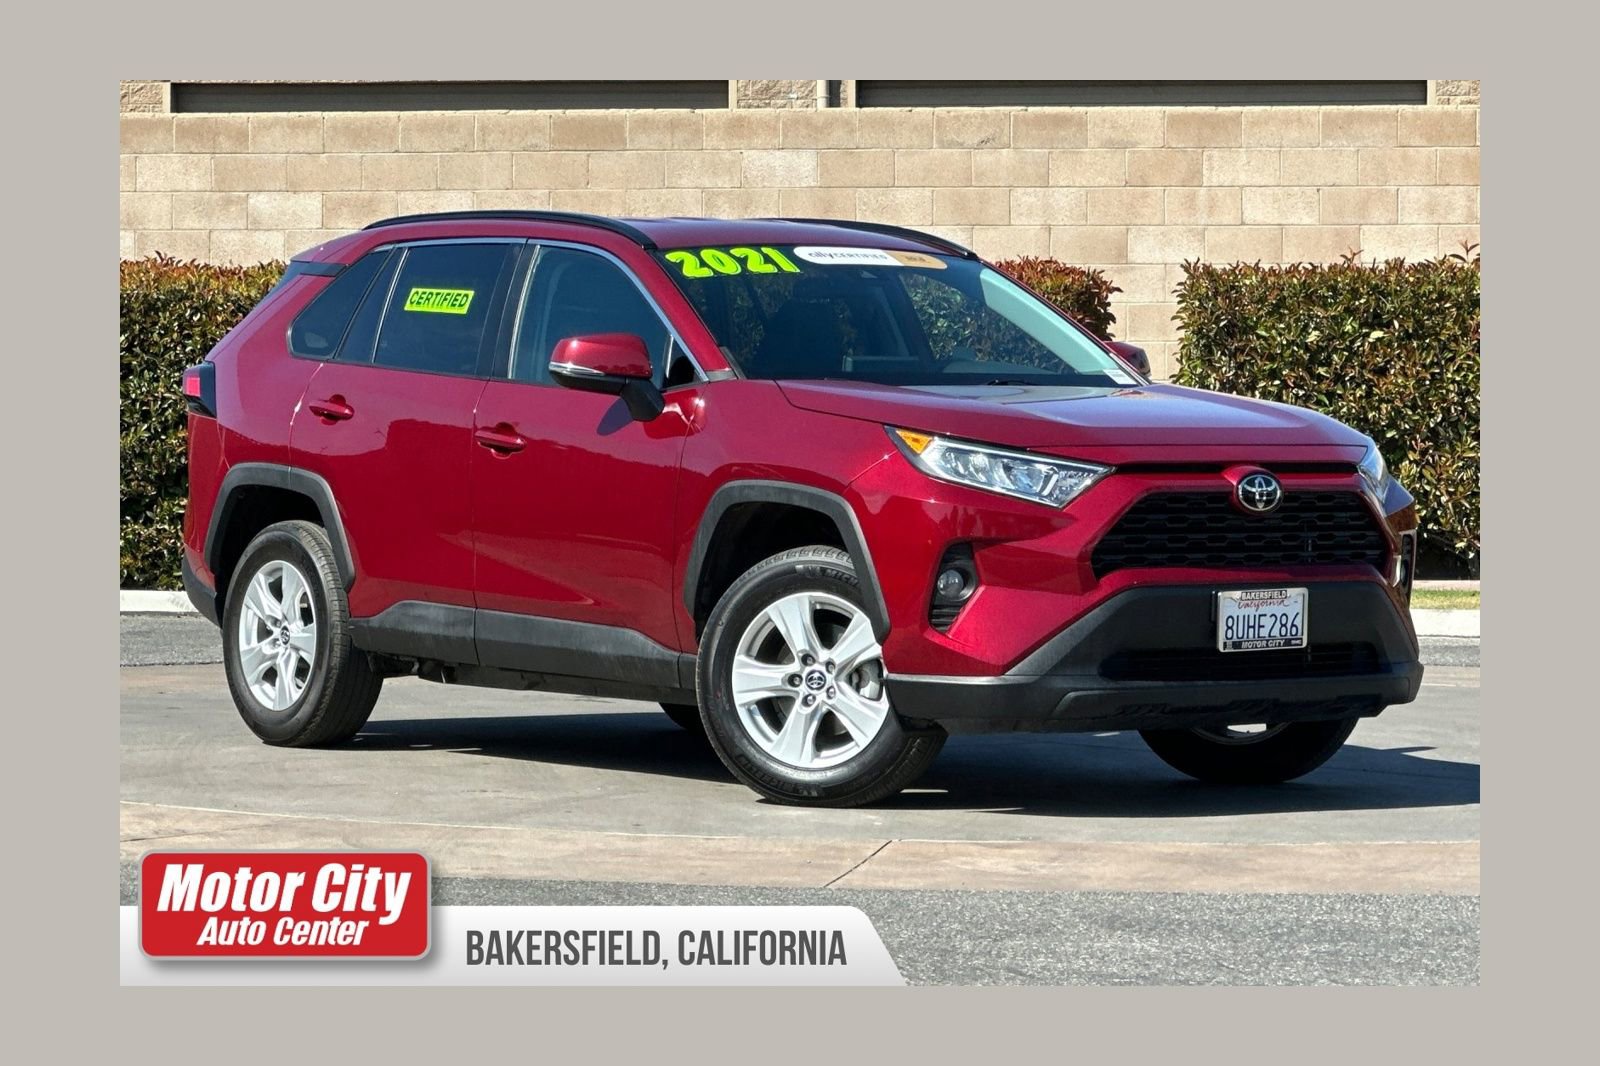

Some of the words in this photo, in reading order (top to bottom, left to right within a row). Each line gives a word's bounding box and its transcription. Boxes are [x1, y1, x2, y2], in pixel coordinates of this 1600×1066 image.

[665, 247, 800, 277] 2021
[409, 290, 469, 307] CERTIFIED
[1241, 591, 1286, 600] BAKERSFIELD
[1225, 612, 1300, 640] 8UHE286
